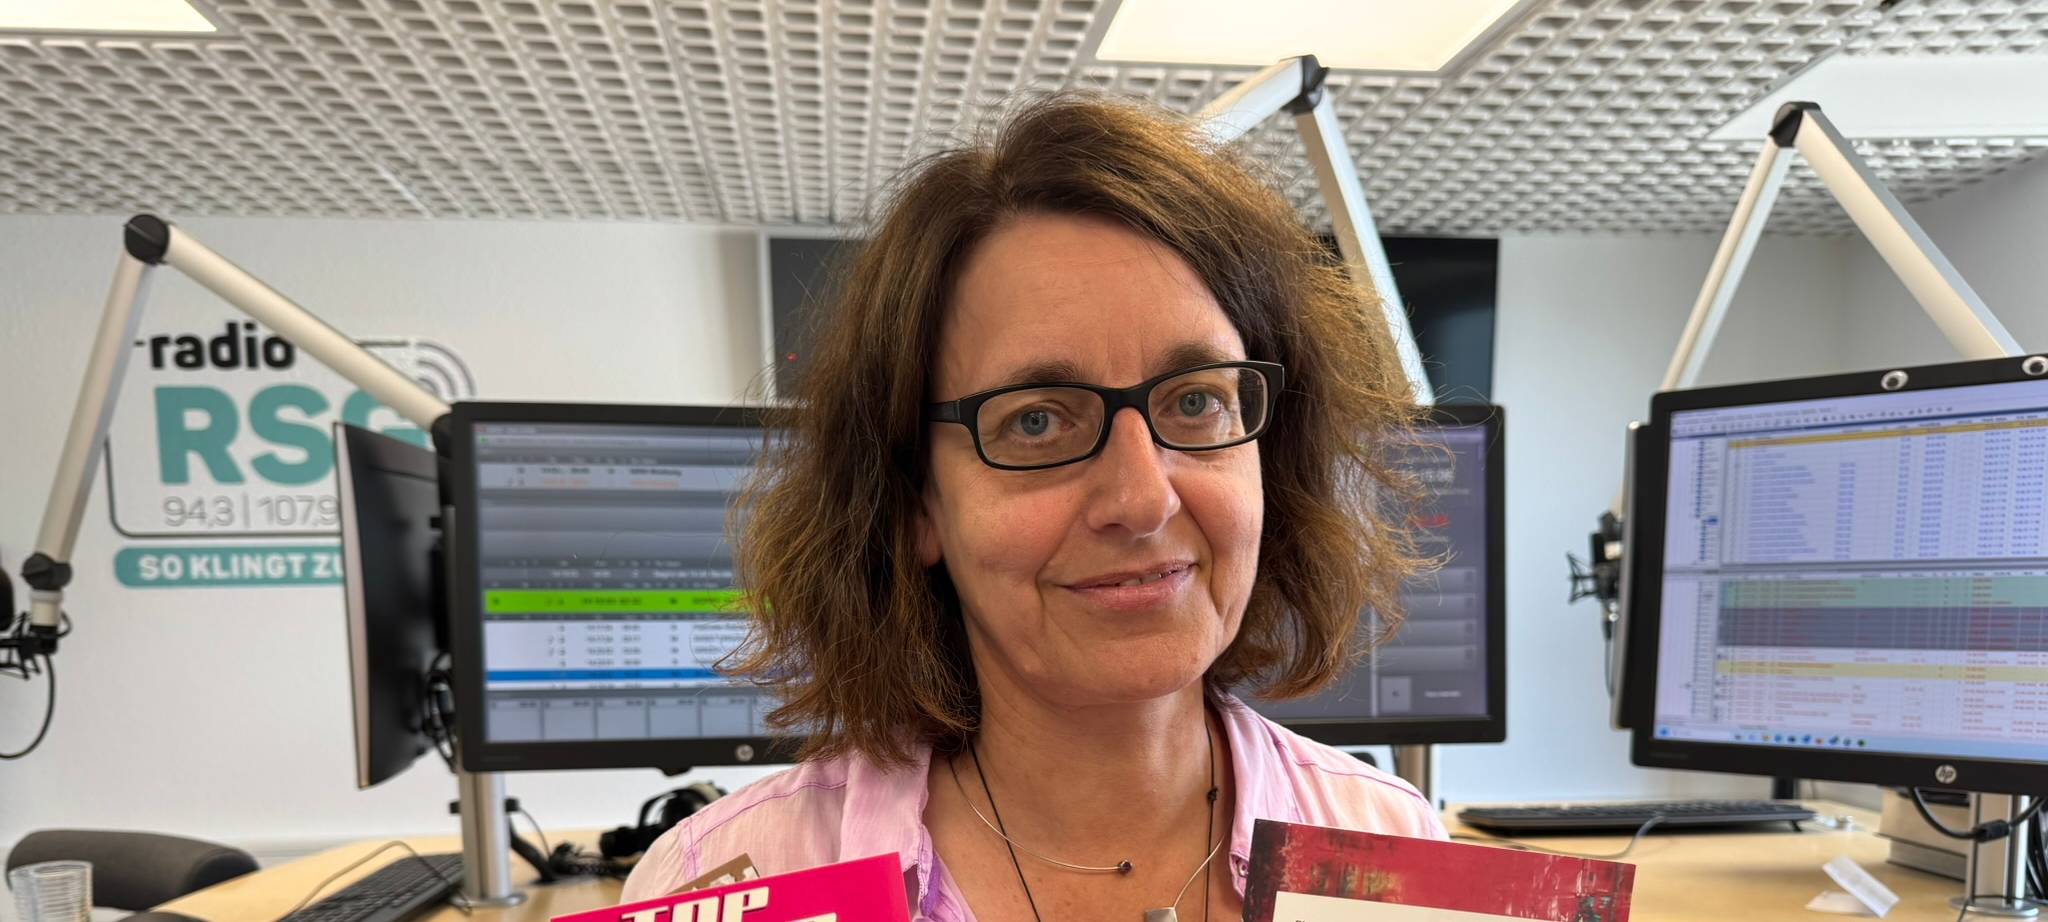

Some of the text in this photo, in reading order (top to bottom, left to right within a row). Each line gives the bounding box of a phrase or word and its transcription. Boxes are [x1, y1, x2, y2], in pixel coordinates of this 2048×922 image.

[150, 321, 296, 370] radio
[164, 496, 234, 528] 94,3
[257, 495, 338, 528] 107,9
[138, 554, 184, 581] SO
[190, 553, 306, 580] KLINGT
